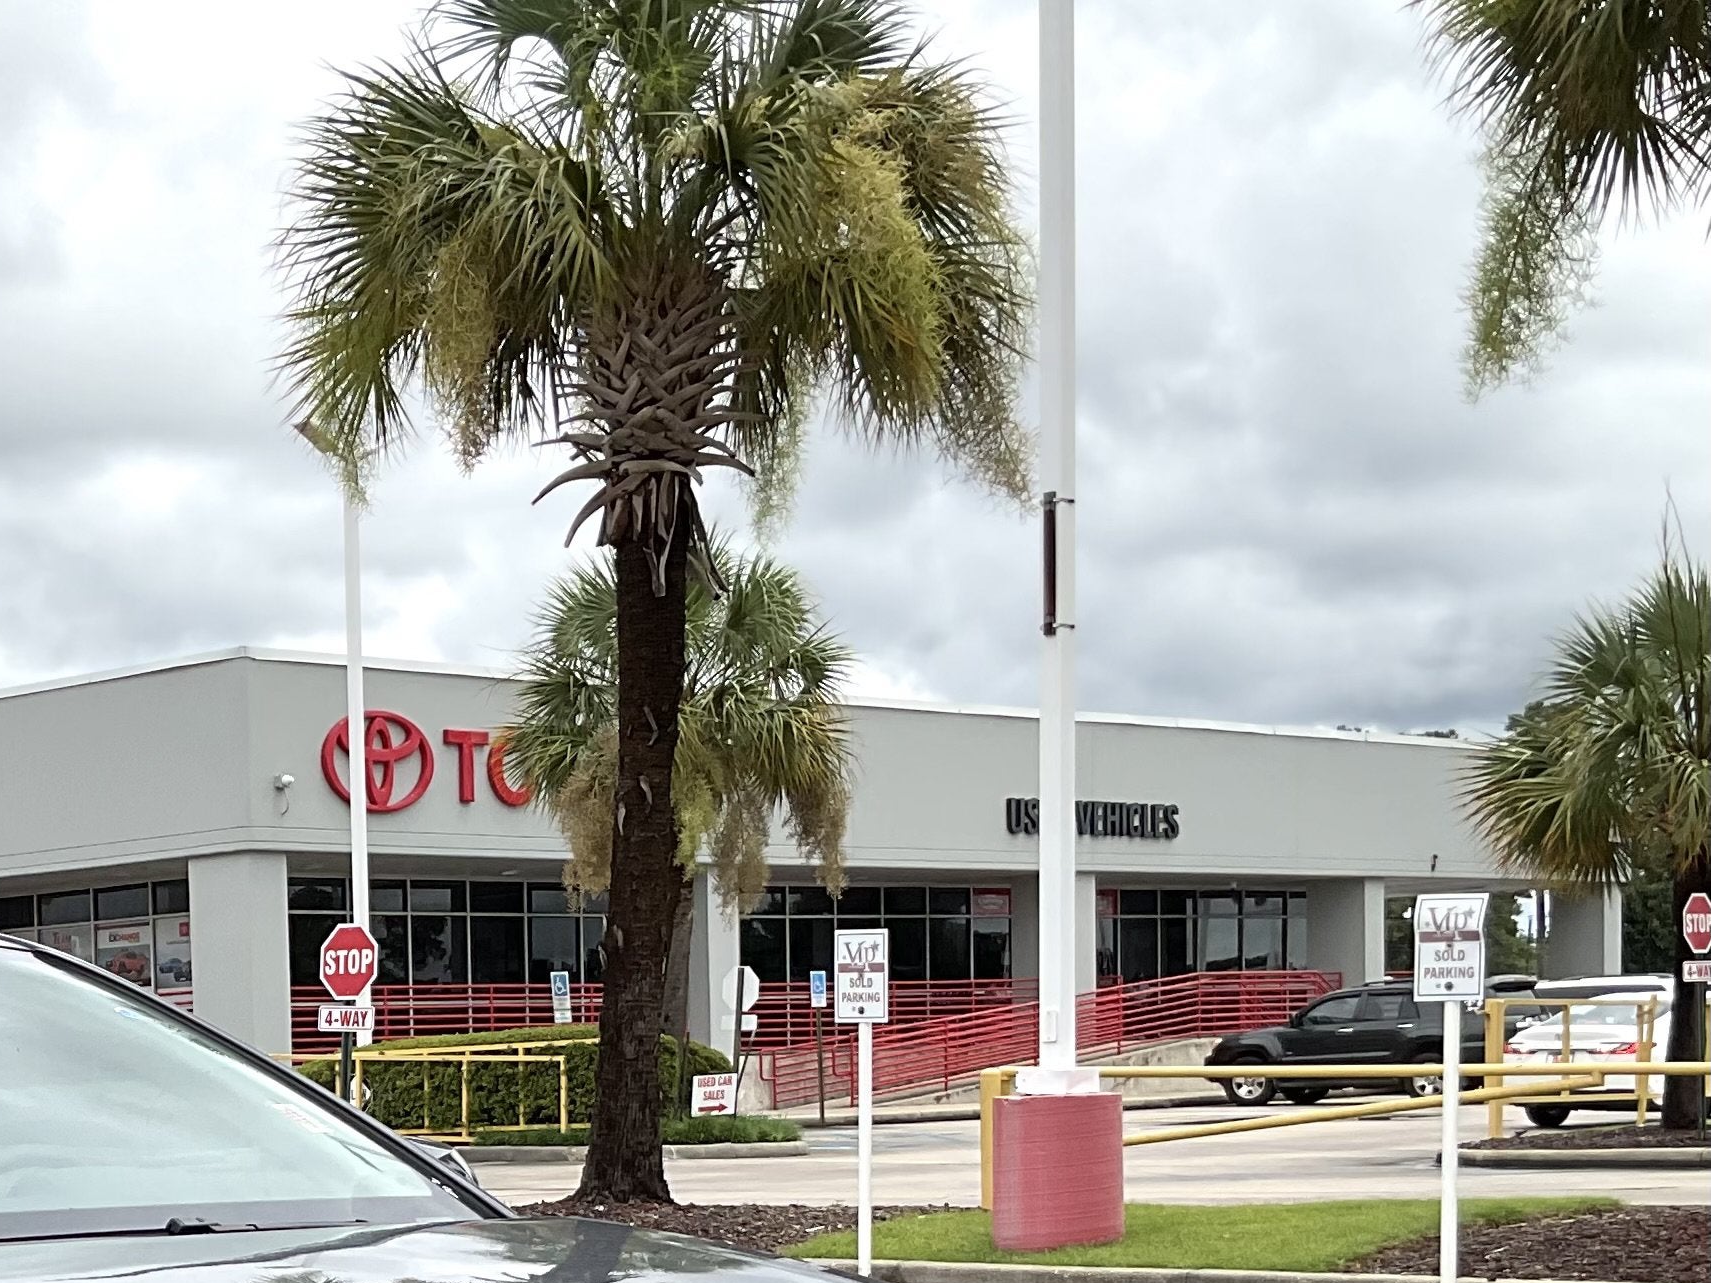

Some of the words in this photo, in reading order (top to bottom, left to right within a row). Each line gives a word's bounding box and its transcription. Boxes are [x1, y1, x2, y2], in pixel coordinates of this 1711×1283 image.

[1074, 799, 1180, 839] VEHICLES
[324, 948, 373, 976] STOP
[1433, 949, 1466, 962] SOLD
[1423, 966, 1475, 979] PARKING
[1687, 964, 1711, 978] 4-WA
[849, 977, 873, 988] SOLD
[841, 991, 881, 1003] PARKING
[324, 1010, 368, 1027] 4-WAY
[697, 1076, 716, 1088] USED
[717, 1075, 733, 1086] CAR
[702, 1089, 725, 1101] SALES
